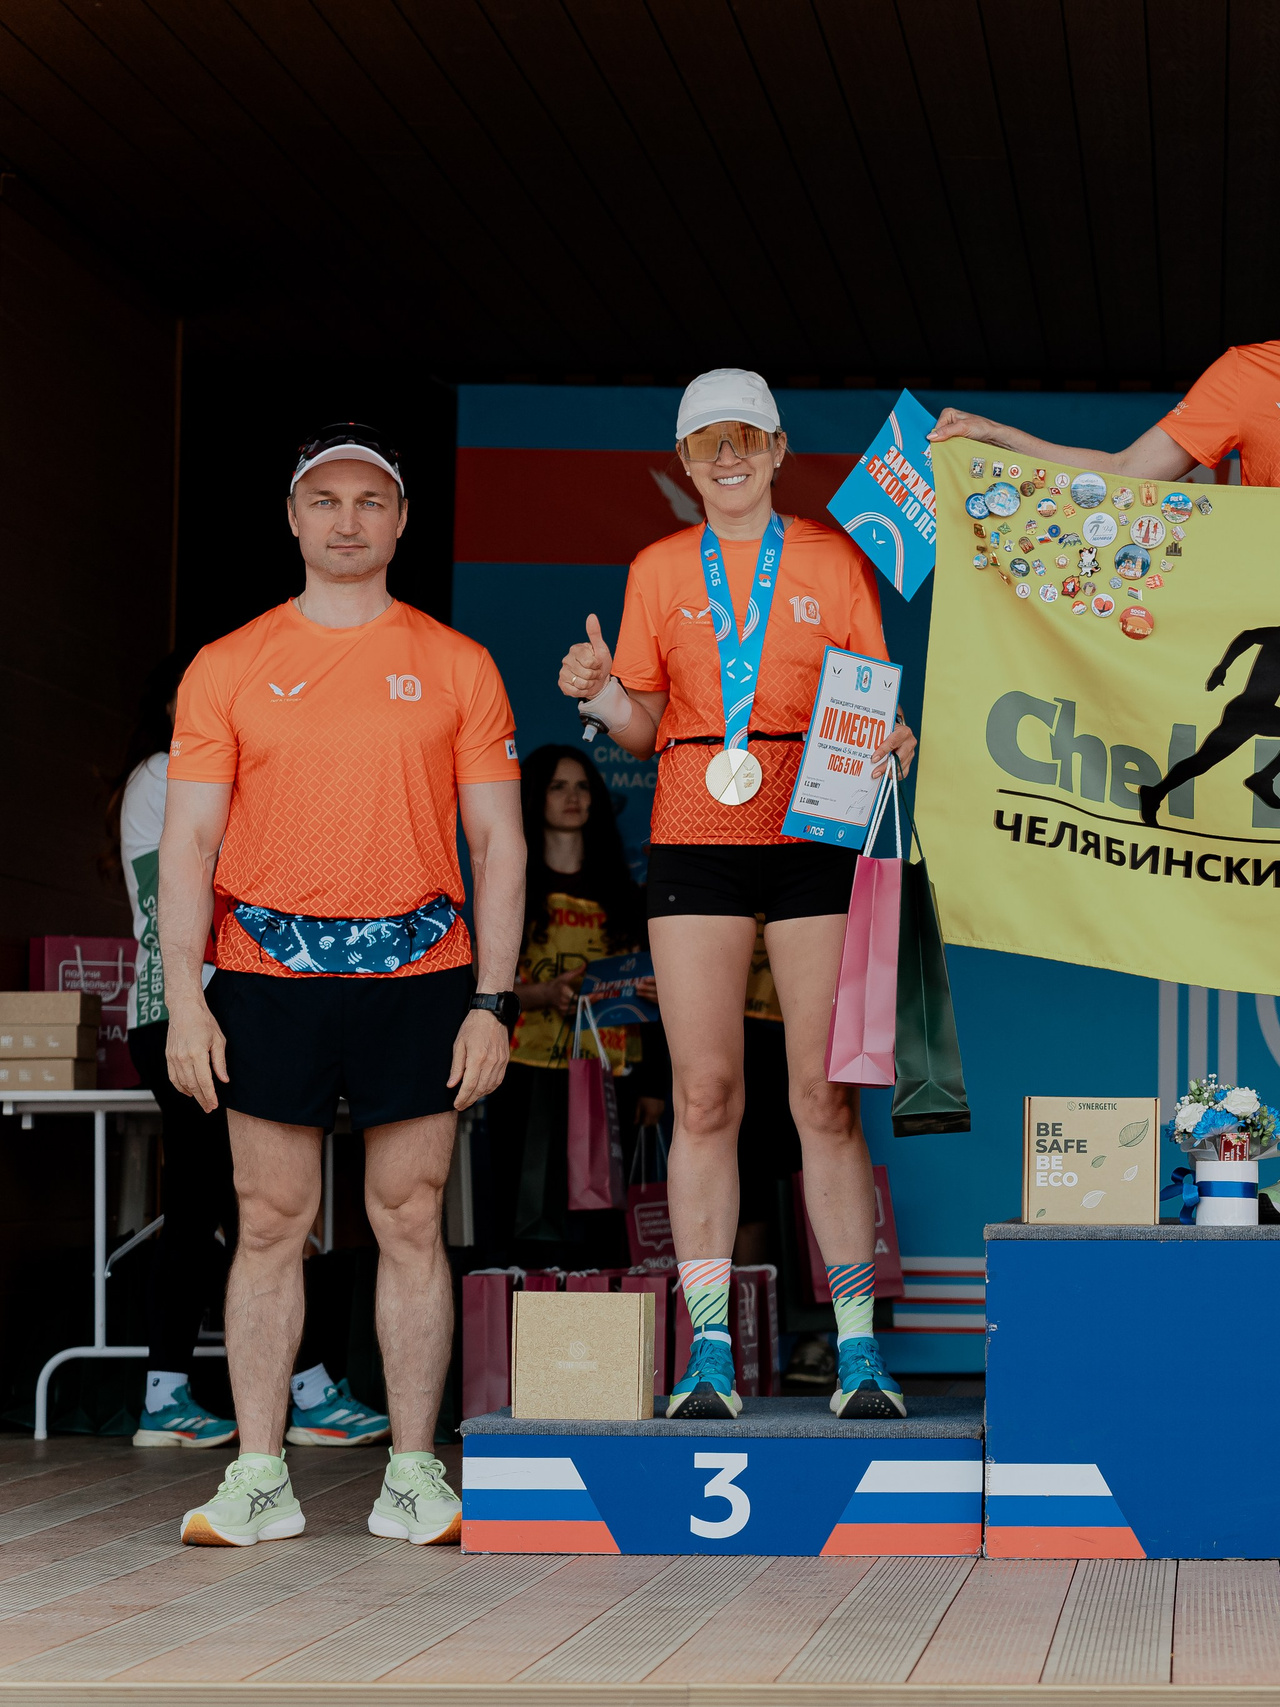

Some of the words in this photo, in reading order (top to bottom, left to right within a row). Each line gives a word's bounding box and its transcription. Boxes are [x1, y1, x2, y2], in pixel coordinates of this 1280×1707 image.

[865, 453, 909, 508] БЕГОМ
[902, 495, 921, 522] 10
[762, 548, 776, 573] ПСБ
[708, 561, 722, 587] ПСБ
[788, 595, 821, 625] 10
[385, 674, 422, 701] 10
[855, 665, 873, 694] 10
[835, 710, 886, 751] МЕСТО
[827, 753, 845, 775] ПСБ
[844, 758, 852, 775] 5
[849, 759, 864, 777] КМ
[809, 826, 825, 837] ПСБ
[1078, 1102, 1118, 1111] SYNERGETIC
[1036, 1122, 1063, 1137] BE
[1035, 1139, 1088, 1153] SAFE
[1036, 1155, 1063, 1170] BE
[1036, 1171, 1079, 1187] ECO
[690, 1452, 751, 1539] 3
